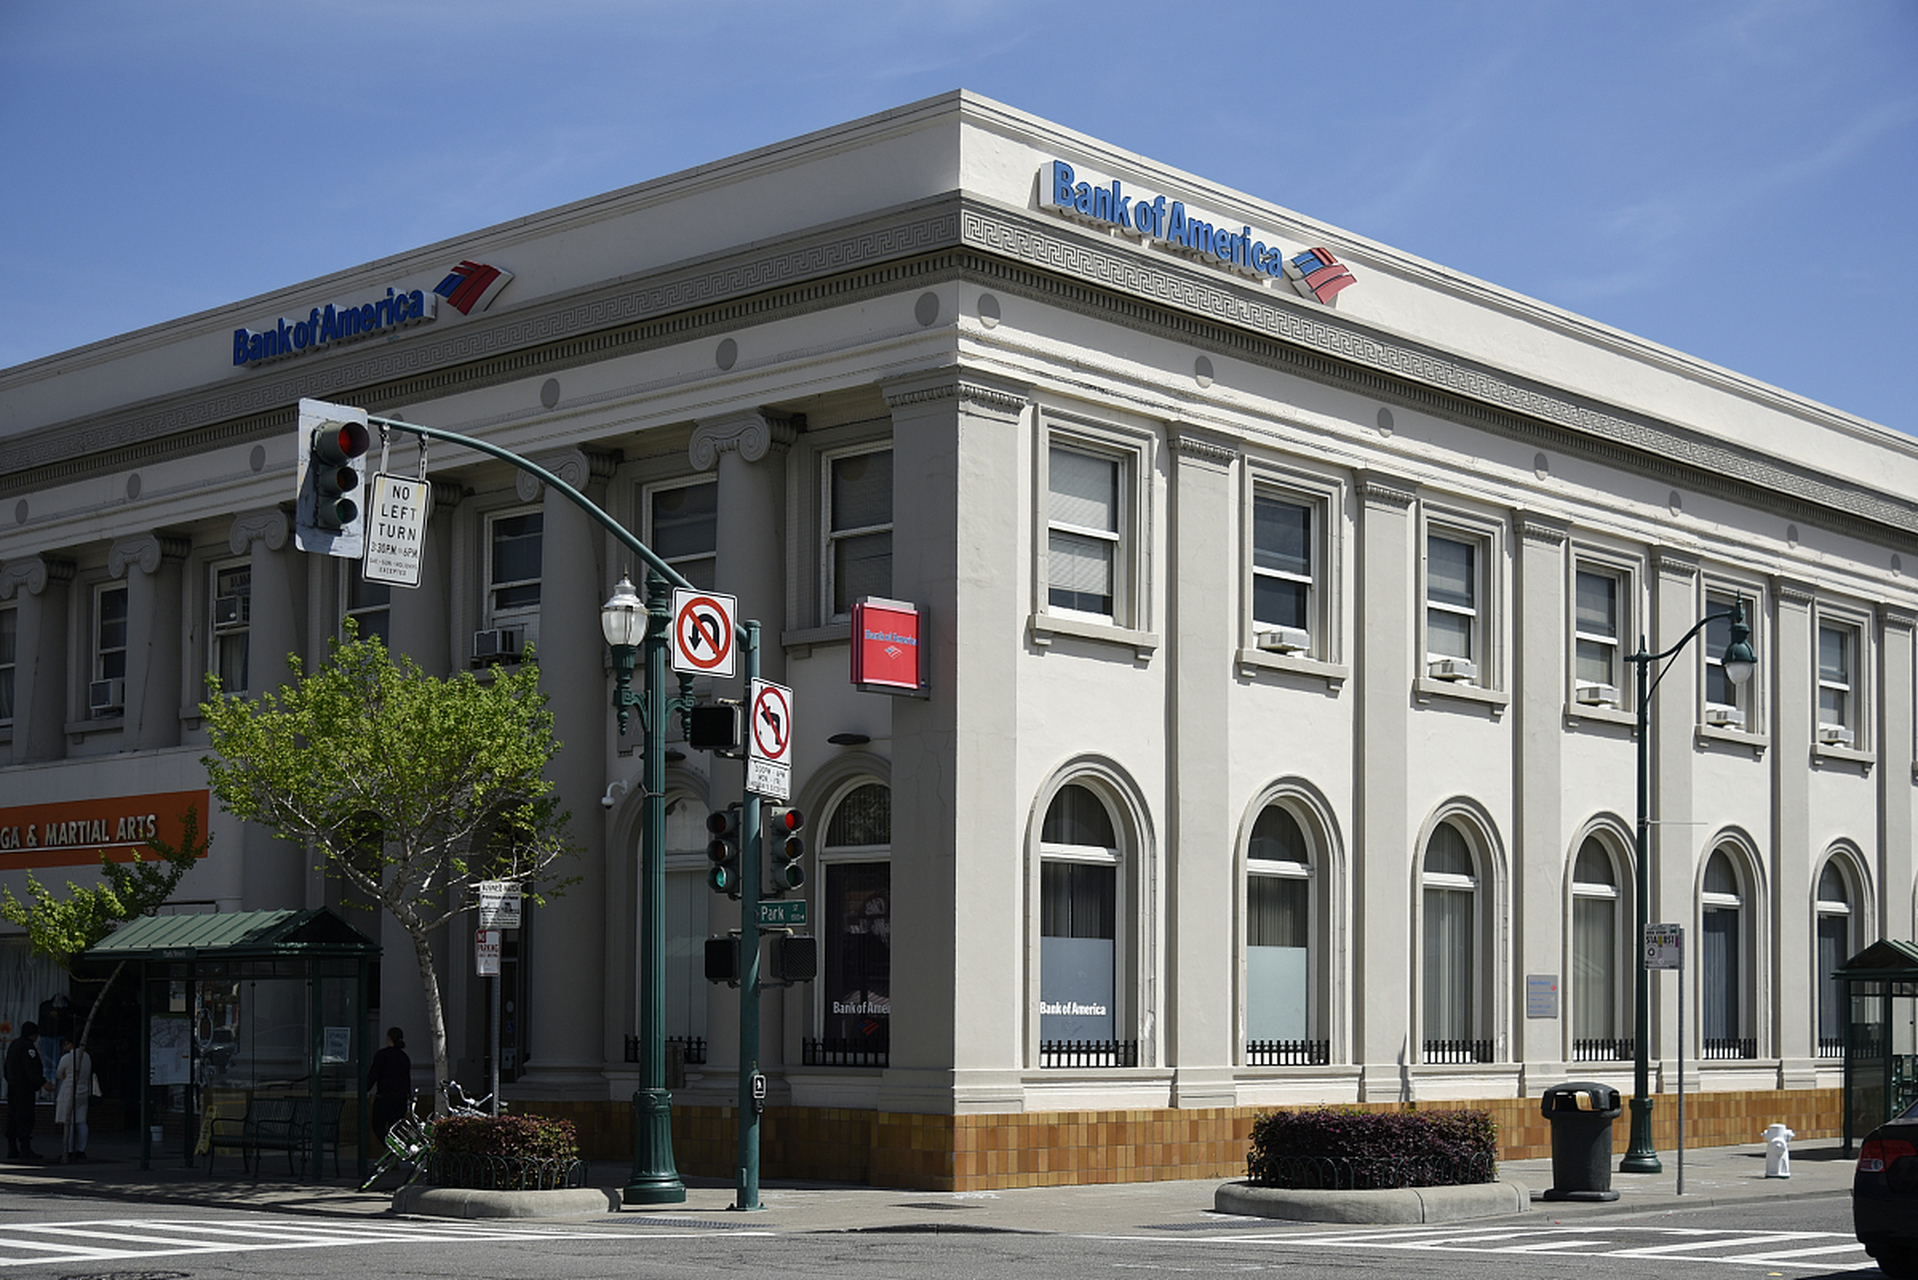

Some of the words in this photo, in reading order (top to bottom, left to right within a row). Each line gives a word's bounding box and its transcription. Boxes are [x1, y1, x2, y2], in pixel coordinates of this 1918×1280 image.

[1053, 160, 1132, 228] Bank
[1134, 195, 1166, 238] of
[1167, 201, 1283, 279] America
[233, 317, 292, 366] Bank
[293, 306, 321, 350] of
[319, 287, 425, 343] America
[392, 485, 410, 500] NO
[381, 503, 417, 521] LEFT
[378, 522, 416, 541] TURN
[865, 629, 884, 641] Bank
[893, 632, 918, 646] America
[26, 824, 38, 847] &
[45, 819, 110, 846] MARTIAL
[116, 813, 157, 841] ARTS
[761, 906, 785, 921] Park
[833, 1001, 856, 1014] Bank
[856, 1001, 867, 1014] of
[1040, 1001, 1061, 1015] Bank
[1062, 1001, 1071, 1015] of
[1072, 1001, 1106, 1015] America
